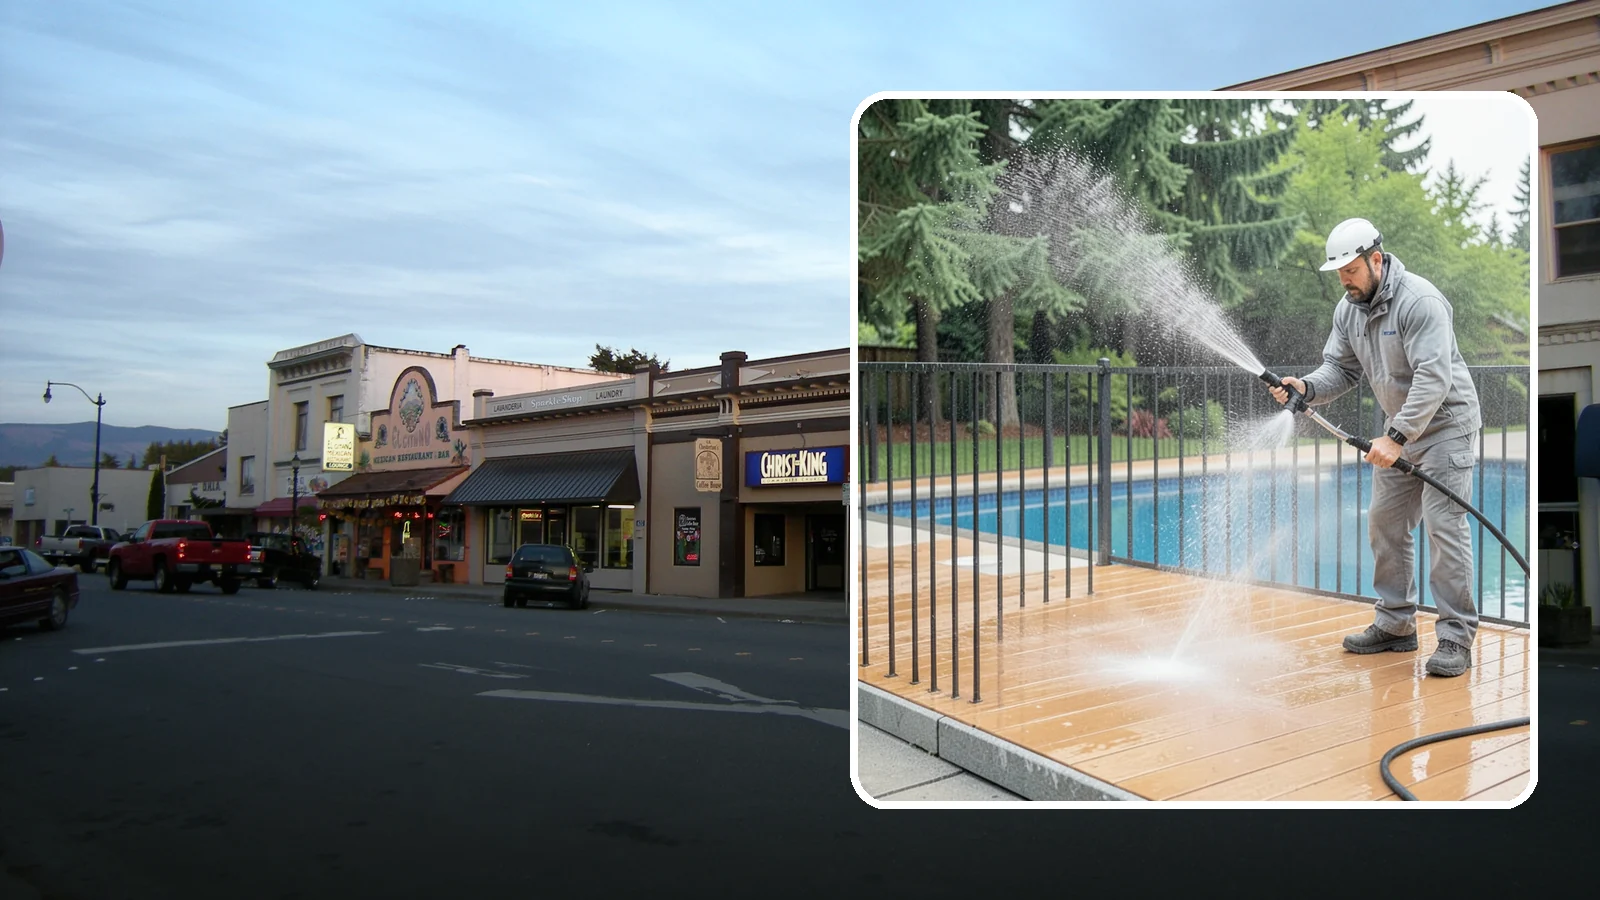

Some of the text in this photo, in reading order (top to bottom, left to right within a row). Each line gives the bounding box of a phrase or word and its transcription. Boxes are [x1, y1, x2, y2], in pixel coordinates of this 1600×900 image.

[494, 389, 624, 412] LAVANDERIA Sparkle Shop LAUNDRY
[374, 455, 396, 464] MEXICAN
[397, 451, 433, 462] RESTAURANT
[438, 450, 450, 459] BAR
[761, 450, 827, 478] CHRIST KING
